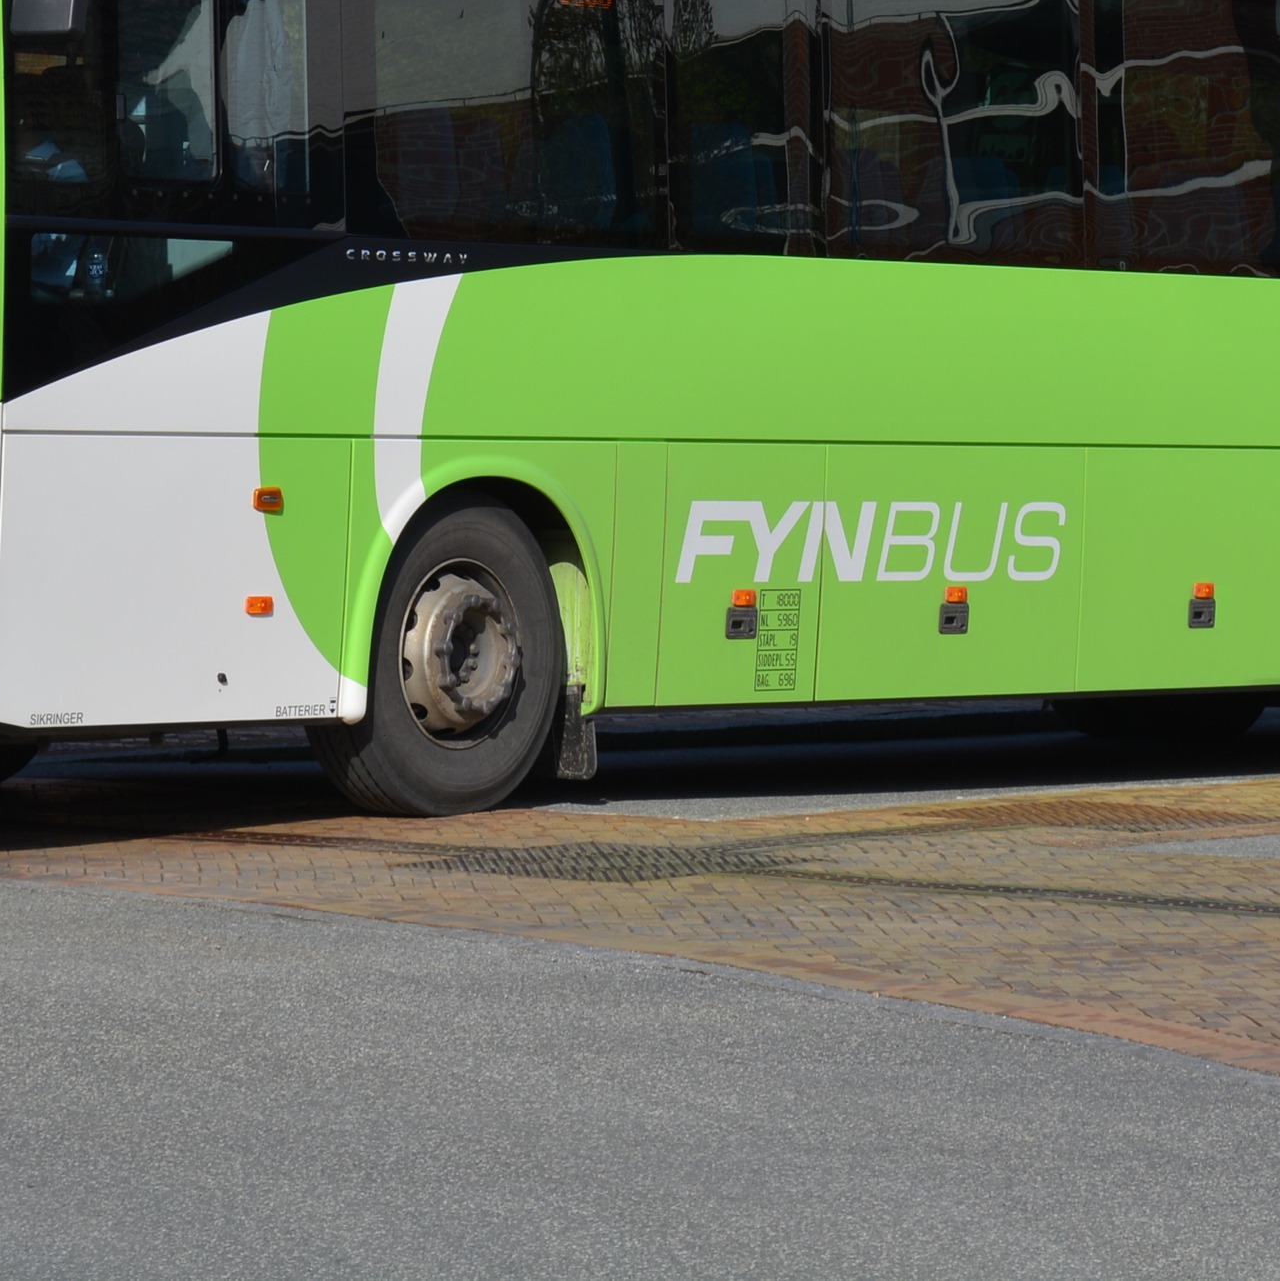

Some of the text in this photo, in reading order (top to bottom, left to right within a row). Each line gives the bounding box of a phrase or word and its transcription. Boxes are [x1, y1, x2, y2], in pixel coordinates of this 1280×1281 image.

[346, 249, 468, 264] CROSSWAY
[675, 501, 1066, 583] FYNBUS
[777, 613, 798, 627] 5960
[778, 673, 794, 687] 696
[275, 704, 326, 718] BATTERIER
[30, 712, 84, 726] SIKRINGER
